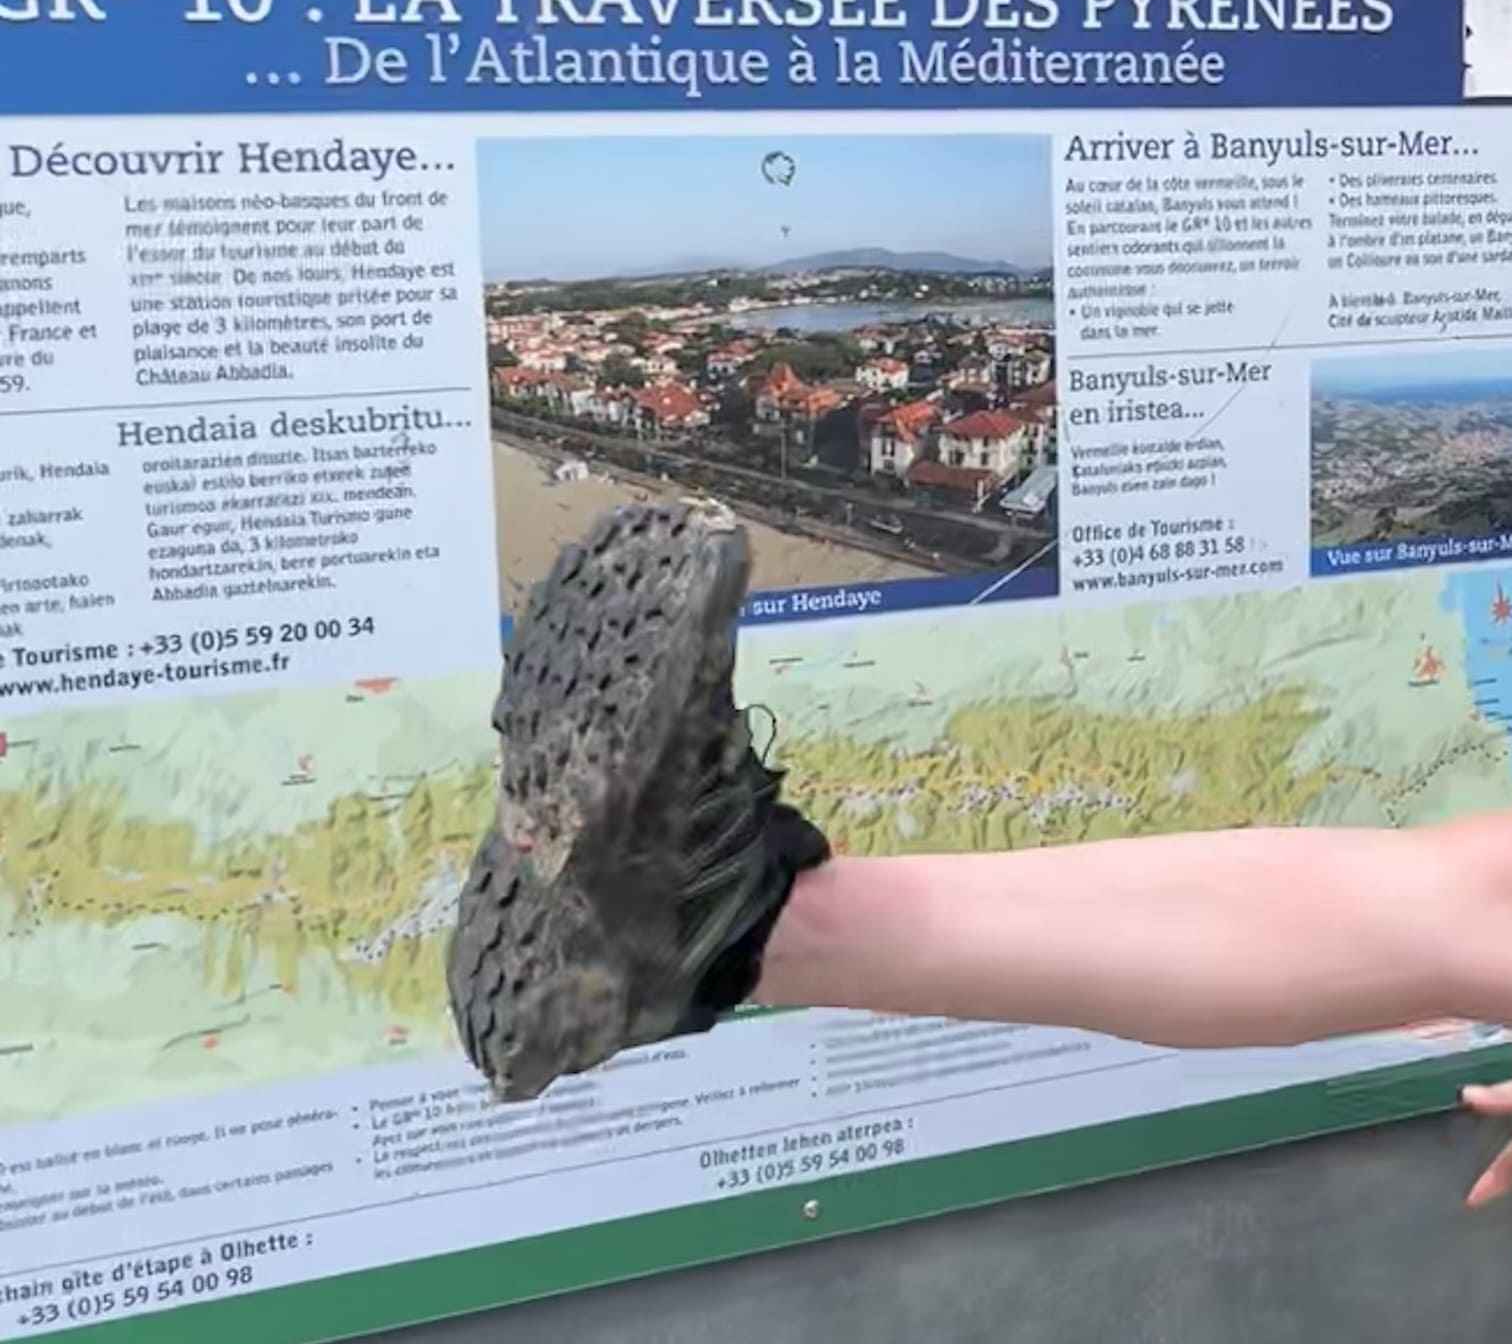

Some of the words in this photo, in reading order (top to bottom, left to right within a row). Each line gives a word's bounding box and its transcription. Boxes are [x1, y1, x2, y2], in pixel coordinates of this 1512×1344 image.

[325, 37, 408, 83] De
[425, 33, 770, 93] l'Atlantique
[788, 35, 818, 82] à
[833, 37, 883, 83] la
[898, 38, 1227, 83] Méditerranée
[9, 141, 224, 177] Découvrir
[237, 139, 457, 181] Hendaye...
[1064, 132, 1176, 161] Arriver
[1184, 131, 1202, 159] à
[1210, 130, 1481, 167] Banyuls-sur-Mer...
[9, 324, 74, 342] France
[79, 325, 99, 339] et
[132, 320, 183, 339] plage
[186, 319, 211, 334] de
[215, 316, 230, 334] 3
[233, 315, 334, 331] kilomètres,
[336, 315, 367, 328] son
[371, 312, 408, 329] port
[412, 310, 434, 325] de
[134, 345, 220, 364] plaisance
[223, 342, 245, 357] et
[247, 340, 266, 356] la
[269, 339, 331, 354] beauté
[335, 335, 399, 352] insolite
[402, 333, 425, 349] du
[1068, 362, 1273, 395] Banyuls-sur-Mer
[117, 414, 258, 446] Hendaia
[270, 405, 473, 437] deskubritu...
[1069, 408, 1101, 425] en
[1108, 400, 1205, 423] iristea...
[1072, 525, 1123, 543] Office
[1128, 523, 1147, 538] de
[1151, 519, 1225, 536] Tourisme
[1072, 549, 1106, 567] +33
[1110, 546, 1145, 565] (0)4
[1150, 543, 1171, 561] 68
[1174, 541, 1196, 558] 88
[1200, 539, 1220, 556] 31
[1224, 536, 1246, 554] 58
[1326, 550, 1363, 565] Vue
[1365, 549, 1393, 562] sur
[1072, 561, 1285, 590] www.banyuls-sur-mer.com
[753, 595, 786, 615] sur
[791, 588, 882, 612] Hendaye
[12, 644, 119, 666] Tourisme
[127, 644, 135, 657] :
[140, 634, 183, 654] +33
[190, 629, 240, 653] (0)5
[245, 626, 274, 646] 59
[280, 623, 308, 642] 20
[315, 620, 343, 639] 00
[348, 617, 376, 636] 34
[0, 653, 291, 696] www.hendaye-tourisme.fr
[717, 1169, 752, 1188] +33
[755, 1160, 796, 1183] (0)5
[801, 1154, 824, 1172] 59
[828, 1149, 850, 1168] 54
[854, 1143, 878, 1162] 00
[882, 1138, 906, 1156] 98
[0, 1281, 53, 1304] hain
[112, 1255, 195, 1281] d'étape
[199, 1248, 215, 1265] à
[220, 1236, 300, 1261] Olhette
[17, 1304, 61, 1325] +33
[67, 1293, 117, 1319] (0)5
[123, 1286, 151, 1307] 59
[156, 1280, 186, 1300] 54
[190, 1273, 220, 1293] 00
[225, 1266, 255, 1286] 98
